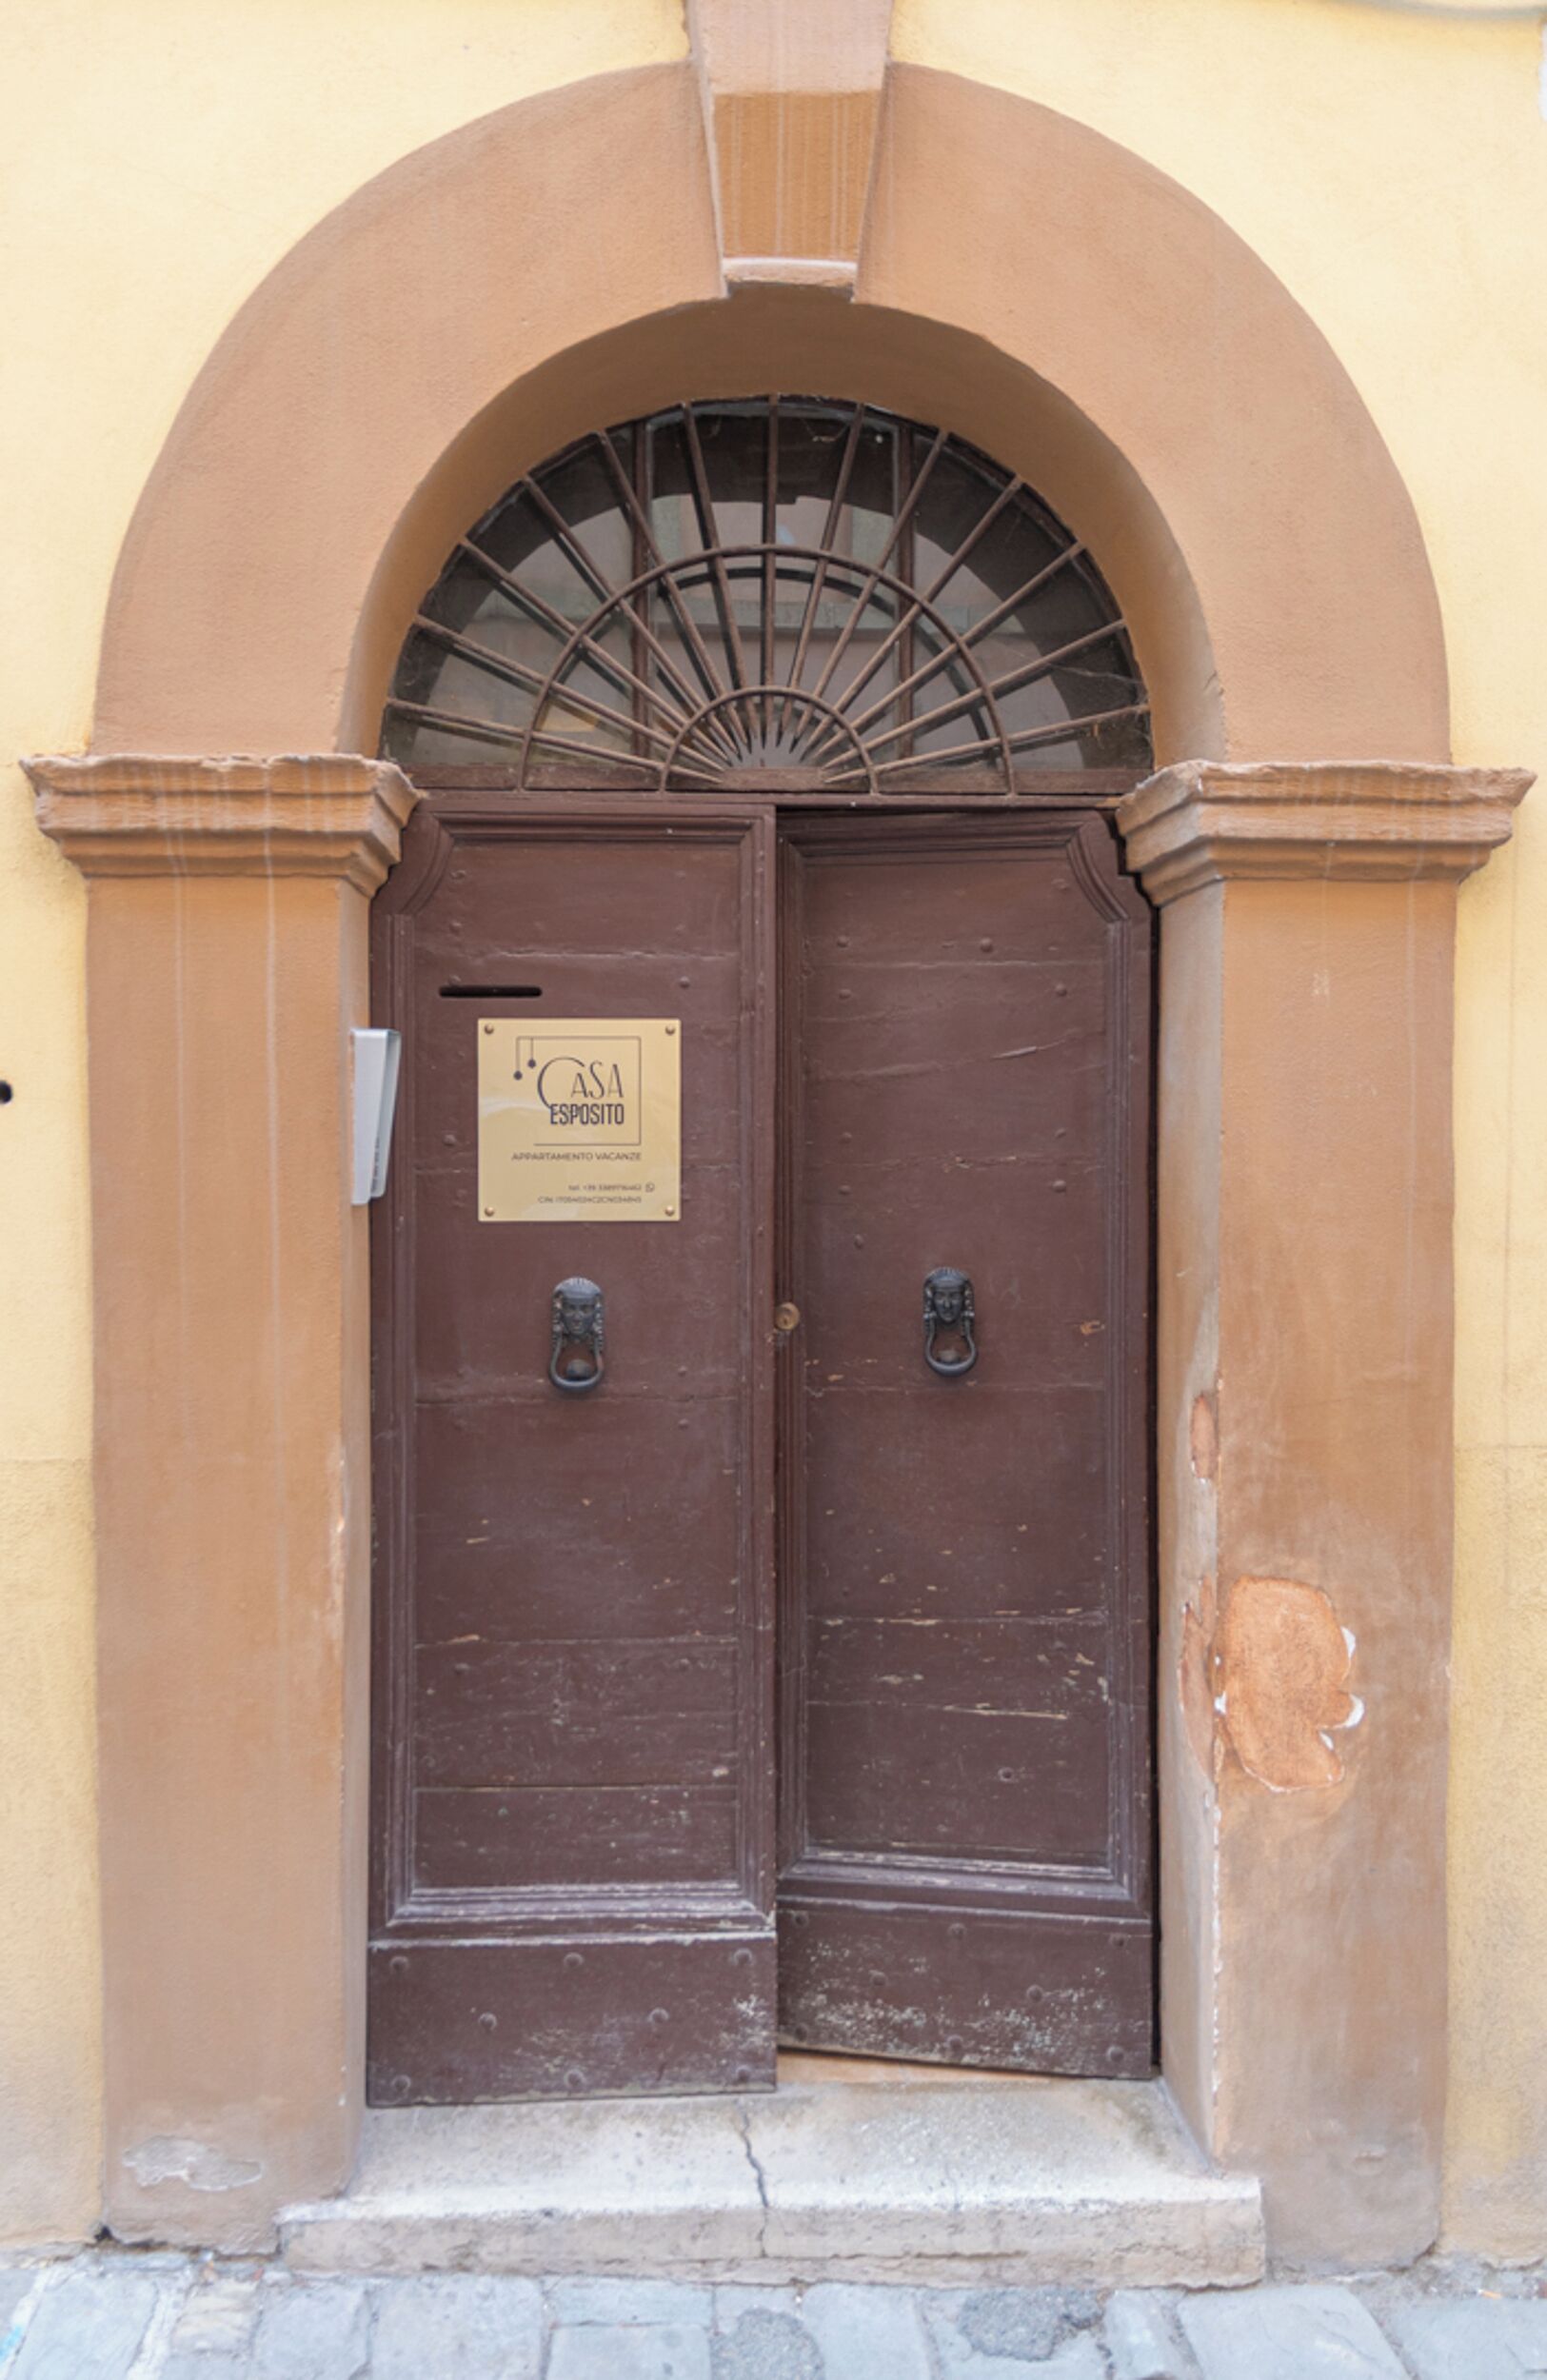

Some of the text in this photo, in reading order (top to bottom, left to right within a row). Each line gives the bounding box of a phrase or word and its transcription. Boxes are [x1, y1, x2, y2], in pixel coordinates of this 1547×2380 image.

[537, 1057, 625, 1109] CASA
[549, 1102, 625, 1125] ESPOSITO
[511, 1152, 642, 1161] APPARTAMENTO VACANZE
